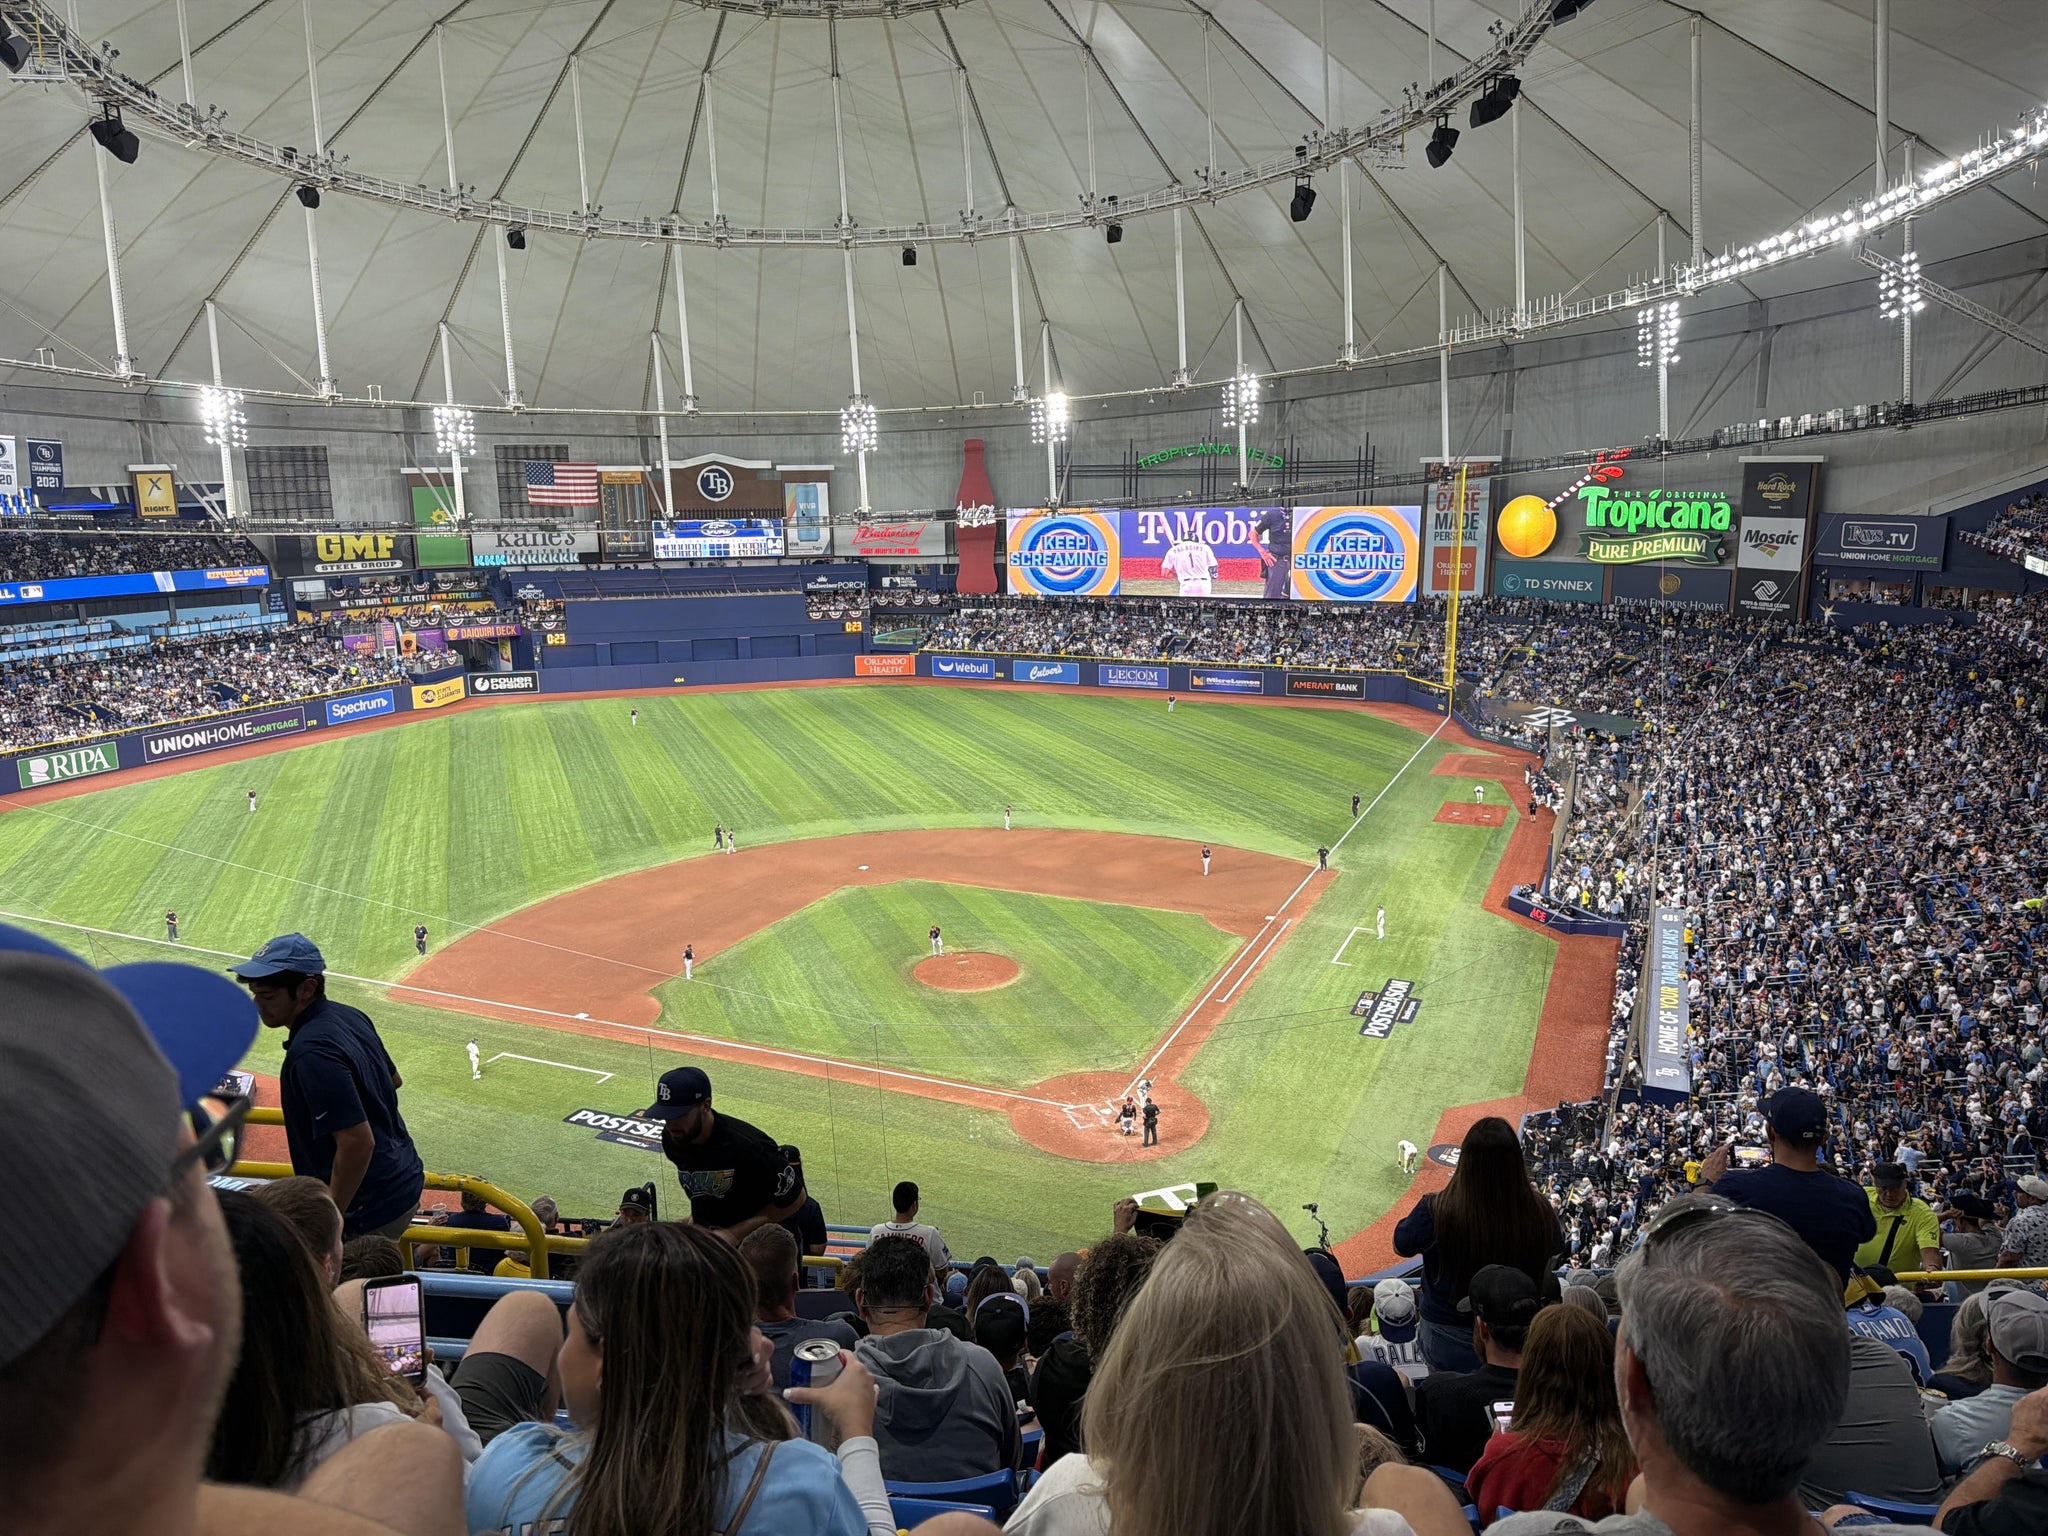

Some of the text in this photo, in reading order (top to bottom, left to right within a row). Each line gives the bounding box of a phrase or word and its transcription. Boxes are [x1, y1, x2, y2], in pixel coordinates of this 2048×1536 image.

[1137, 443, 1231, 469] TROPICANA
[36, 476, 59, 487] 2021
[703, 472, 728, 494] TB
[1757, 481, 1797, 493] Hard Rock
[1666, 491, 1726, 499] ORIGINAL
[1578, 486, 1730, 533] Tropicana
[1434, 513, 1479, 530] MADE
[858, 524, 922, 539] Budweiser
[1743, 529, 1799, 545] Mosaic
[316, 531, 396, 562] GMF
[1043, 536, 1086, 550] KEEP
[1332, 537, 1381, 552] KEEP
[1589, 539, 1707, 559] PURE PREMIUM
[321, 561, 397, 571] STEEL GROUP
[1010, 552, 1108, 566] SCREAMING
[1189, 552, 1194, 568] 1
[1294, 554, 1404, 570] SCREAMING
[1840, 552, 1866, 560] UNION
[1867, 553, 1891, 561] HOME
[1892, 555, 1938, 564] MORTGAGE
[207, 568, 266, 580] REPUBLIC BANK
[806, 581, 866, 590] Budweiser PORCH
[1524, 578, 1593, 592] TD SYNNEX
[355, 599, 367, 607] THE
[403, 604, 423, 617] The
[1614, 595, 1725, 612] DREAM FINDERS HOMES
[460, 626, 517, 639] DAIQUIRI DECK
[845, 621, 863, 632] 0:23
[546, 633, 567, 645] 0:23
[864, 657, 907, 666] ORLANDO
[869, 665, 902, 673] HEALTH
[955, 662, 989, 674] Webull
[1029, 664, 1063, 680] Culver's
[1293, 681, 1358, 692] AMERANT BANK
[332, 697, 384, 718] Spectrum
[252, 718, 300, 735] MORTGAGE
[49, 746, 111, 779] RIPA
[1529, 906, 1547, 923] ACE
[1663, 929, 1679, 948] RAYS
[1662, 948, 1679, 961] BAY
[1661, 961, 1679, 986] TAMPA
[1660, 986, 1679, 1010] YOUR
[1363, 979, 1411, 1038] POSTSEASON
[1659, 1011, 1679, 1027] OF
[1658, 1028, 1679, 1055] HOME
[1655, 1067, 1680, 1077] TB
[659, 1082, 671, 1101] TB
[569, 1109, 665, 1140] POSTSE
[1848, 1318, 1919, 1341] RANDA
